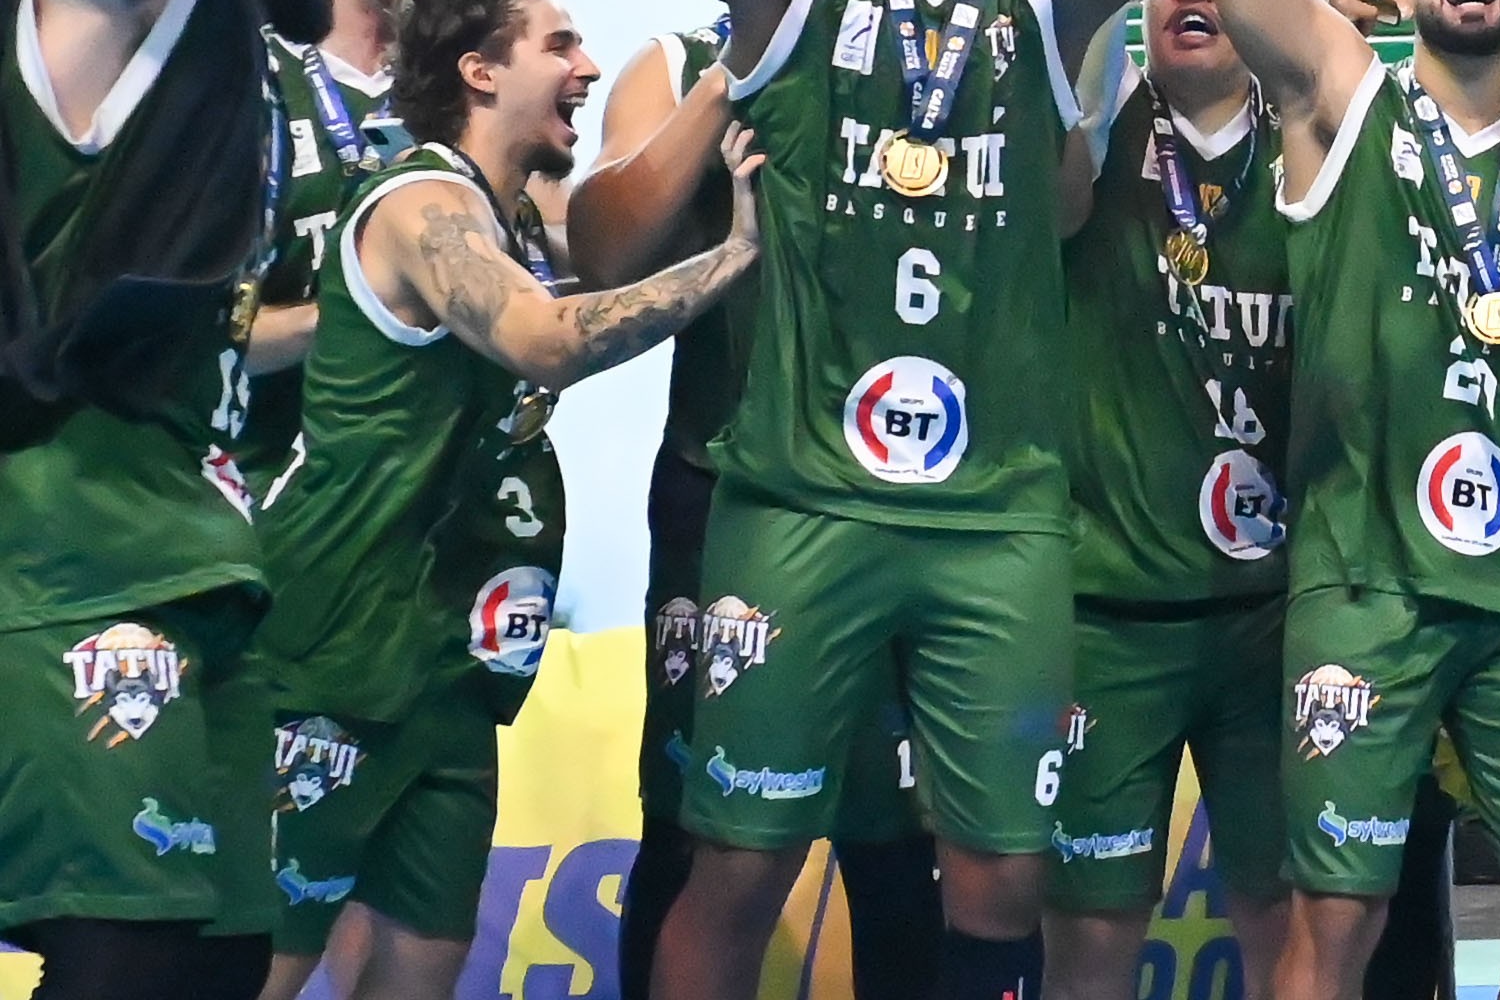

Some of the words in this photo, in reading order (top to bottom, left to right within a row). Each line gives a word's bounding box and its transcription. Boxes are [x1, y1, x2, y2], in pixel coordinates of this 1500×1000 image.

[895, 247, 940, 325] 6
[885, 408, 939, 441] BT
[497, 476, 544, 537] 3
[1451, 478, 1492, 511] BT
[505, 613, 547, 642] BT
[1036, 749, 1063, 806] 6
